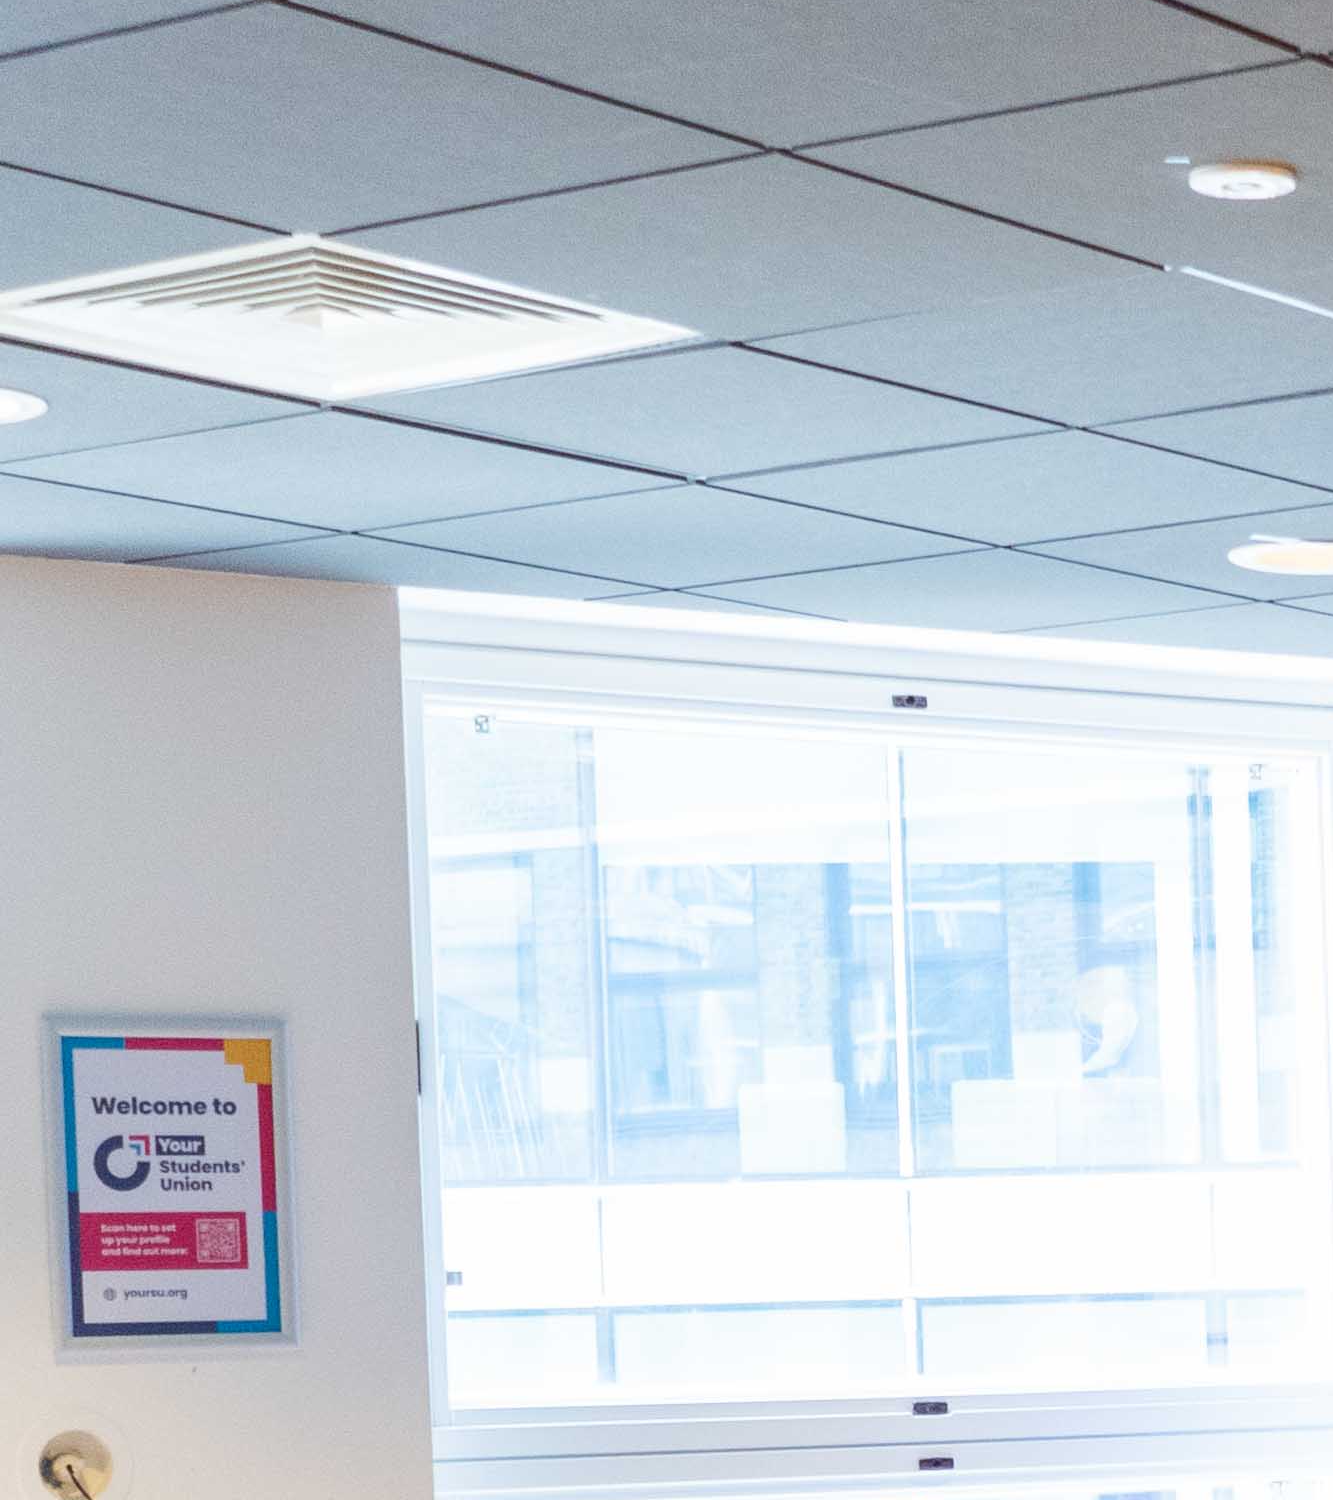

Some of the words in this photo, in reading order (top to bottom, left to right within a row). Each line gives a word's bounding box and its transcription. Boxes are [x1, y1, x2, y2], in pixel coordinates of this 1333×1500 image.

[92, 1097, 207, 1115] Welcome
[212, 1098, 237, 1115] to
[157, 1137, 203, 1153] Your
[159, 1159, 245, 1174] Students'
[160, 1176, 213, 1192] Union
[100, 1223, 125, 1233] Scan
[126, 1223, 148, 1233] here
[149, 1223, 160, 1233] to
[161, 1223, 176, 1233] set
[100, 1236, 115, 1247] up
[116, 1236, 138, 1247] your
[139, 1234, 171, 1246] profile
[101, 1247, 121, 1256] and
[122, 1247, 142, 1256] find
[124, 1288, 188, 1299] yoursu.org
